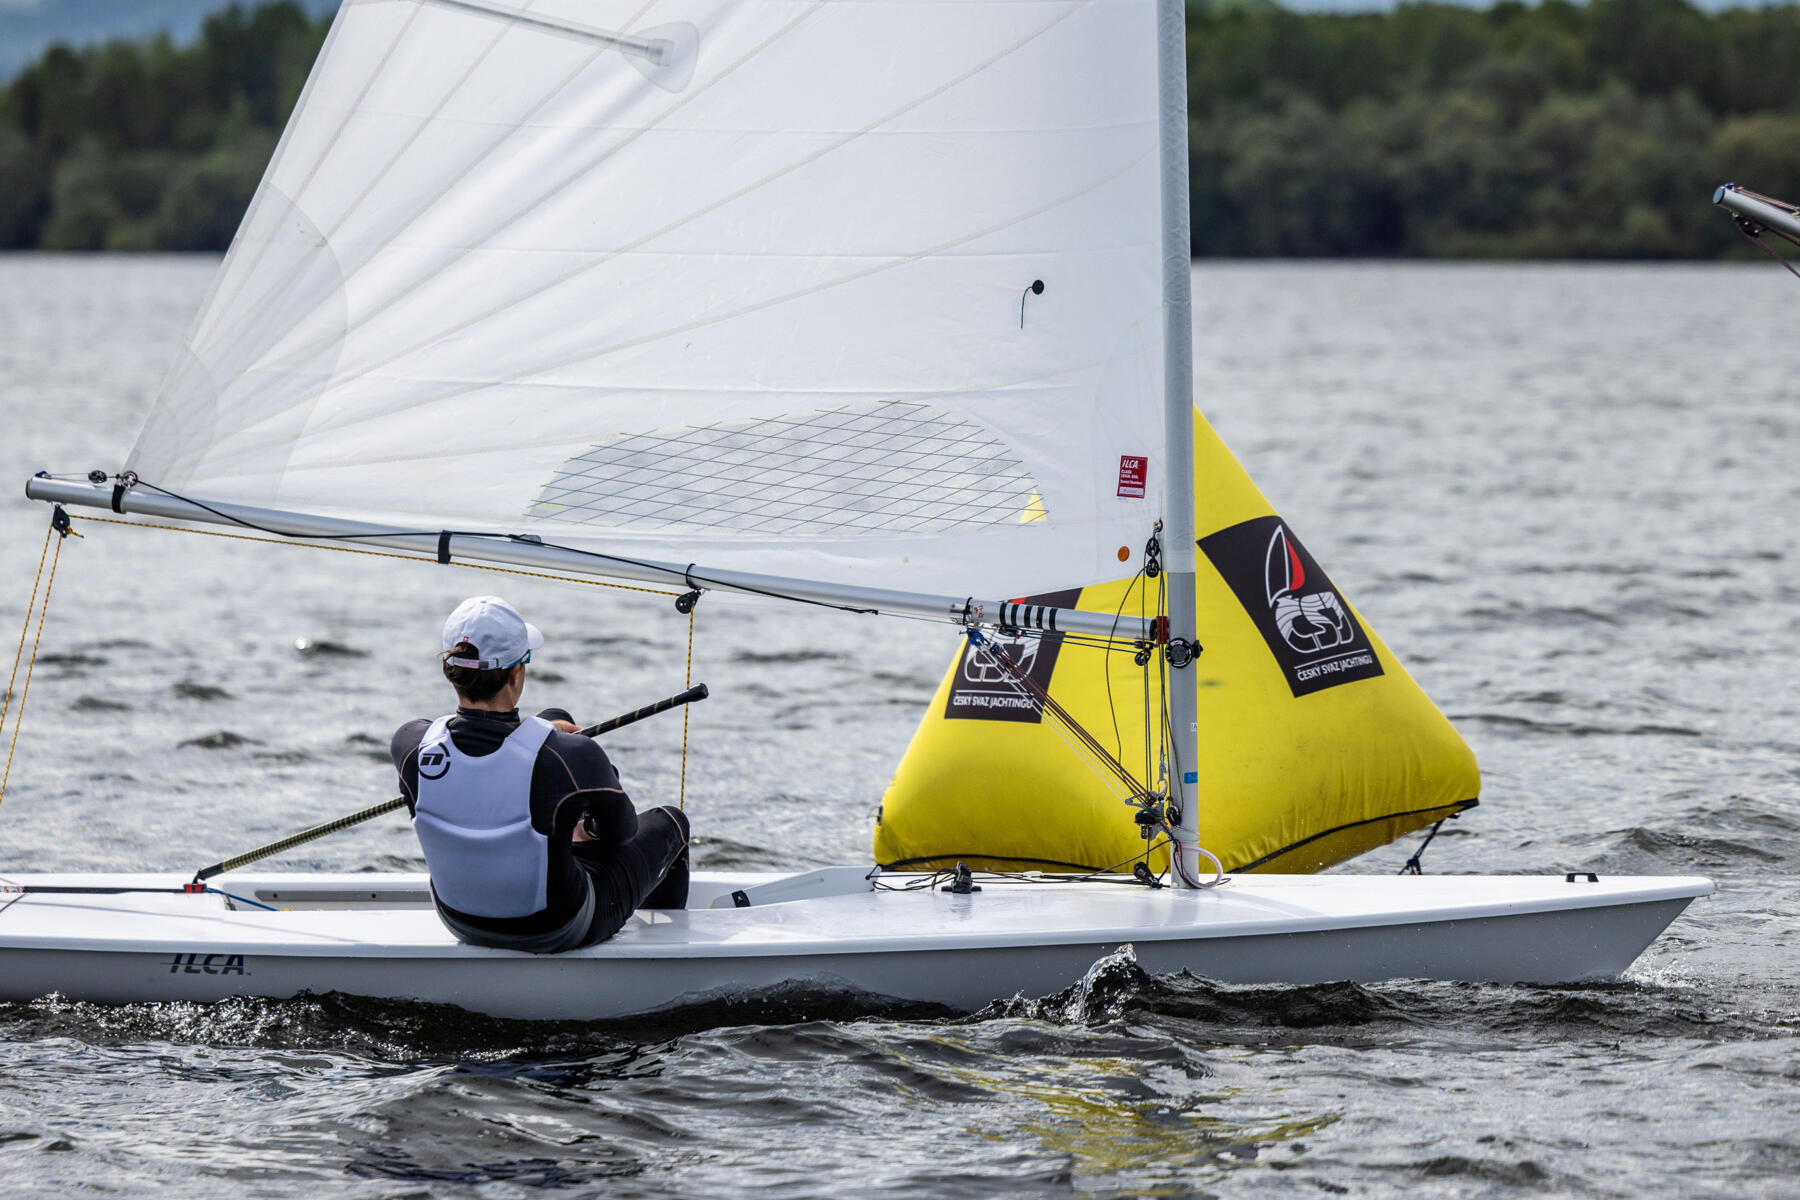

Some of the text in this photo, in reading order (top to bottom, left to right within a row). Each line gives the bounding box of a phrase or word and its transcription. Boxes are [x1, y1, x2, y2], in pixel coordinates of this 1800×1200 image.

[1122, 459, 1139, 469] ILCA
[1297, 654, 1373, 681] ČESKÝ SVAZ JACHTINGU
[953, 694, 1033, 709] ČESKÝ SVAZ JACHTINGU
[170, 953, 245, 976] ILCA
